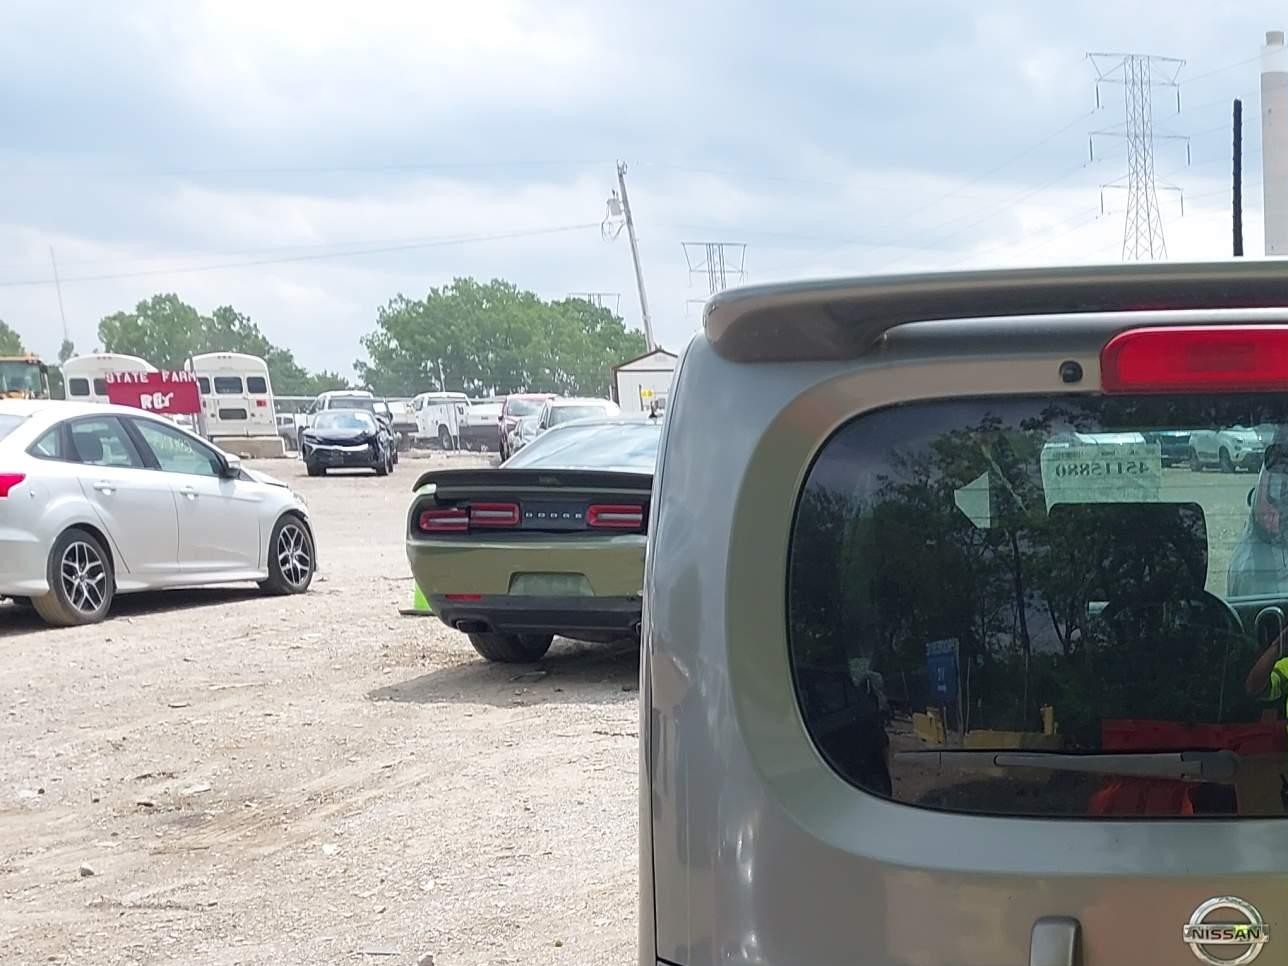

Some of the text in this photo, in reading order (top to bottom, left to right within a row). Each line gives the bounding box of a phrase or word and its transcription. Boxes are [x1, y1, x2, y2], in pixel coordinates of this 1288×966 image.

[106, 370, 197, 383] STATE FARM
[525, 511, 583, 519] DODGE
[1192, 928, 1260, 940] NISSAN
